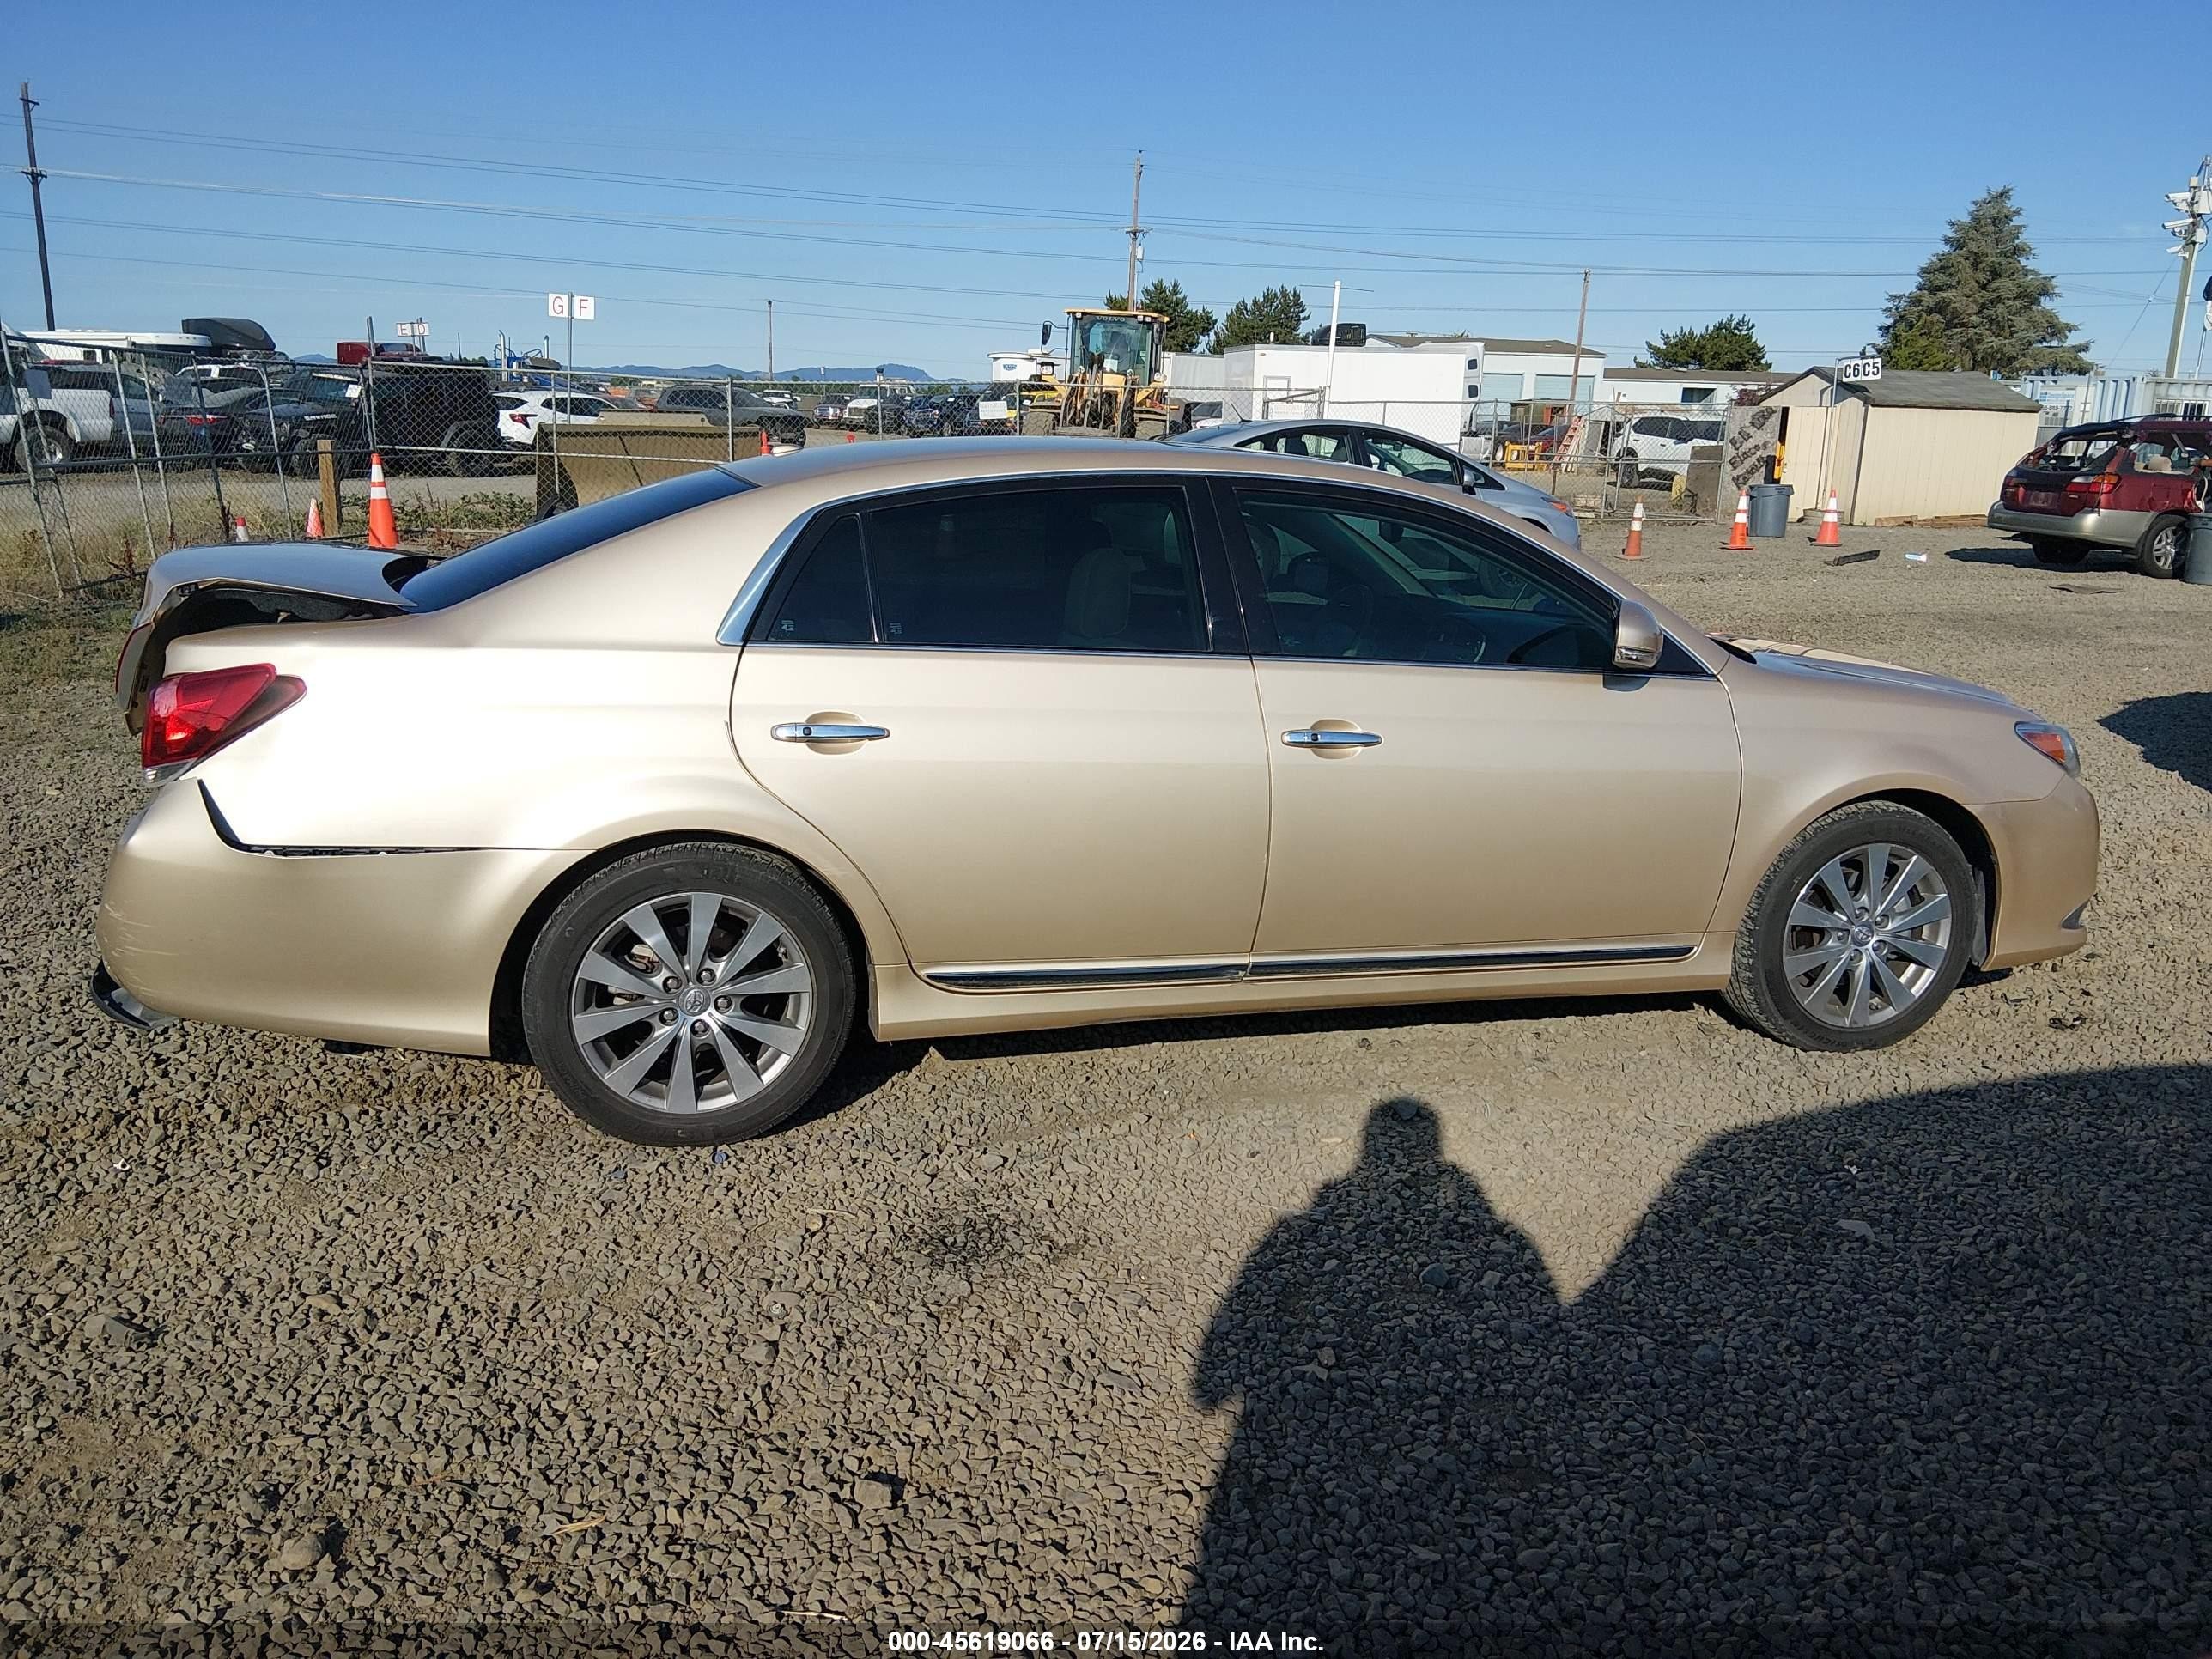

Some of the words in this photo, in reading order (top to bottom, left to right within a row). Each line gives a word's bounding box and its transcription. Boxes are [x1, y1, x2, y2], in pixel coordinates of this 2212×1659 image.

[552, 295, 564, 315] G
[580, 298, 589, 317] F
[1844, 362, 1861, 379] C6
[1863, 361, 1880, 377] C5
